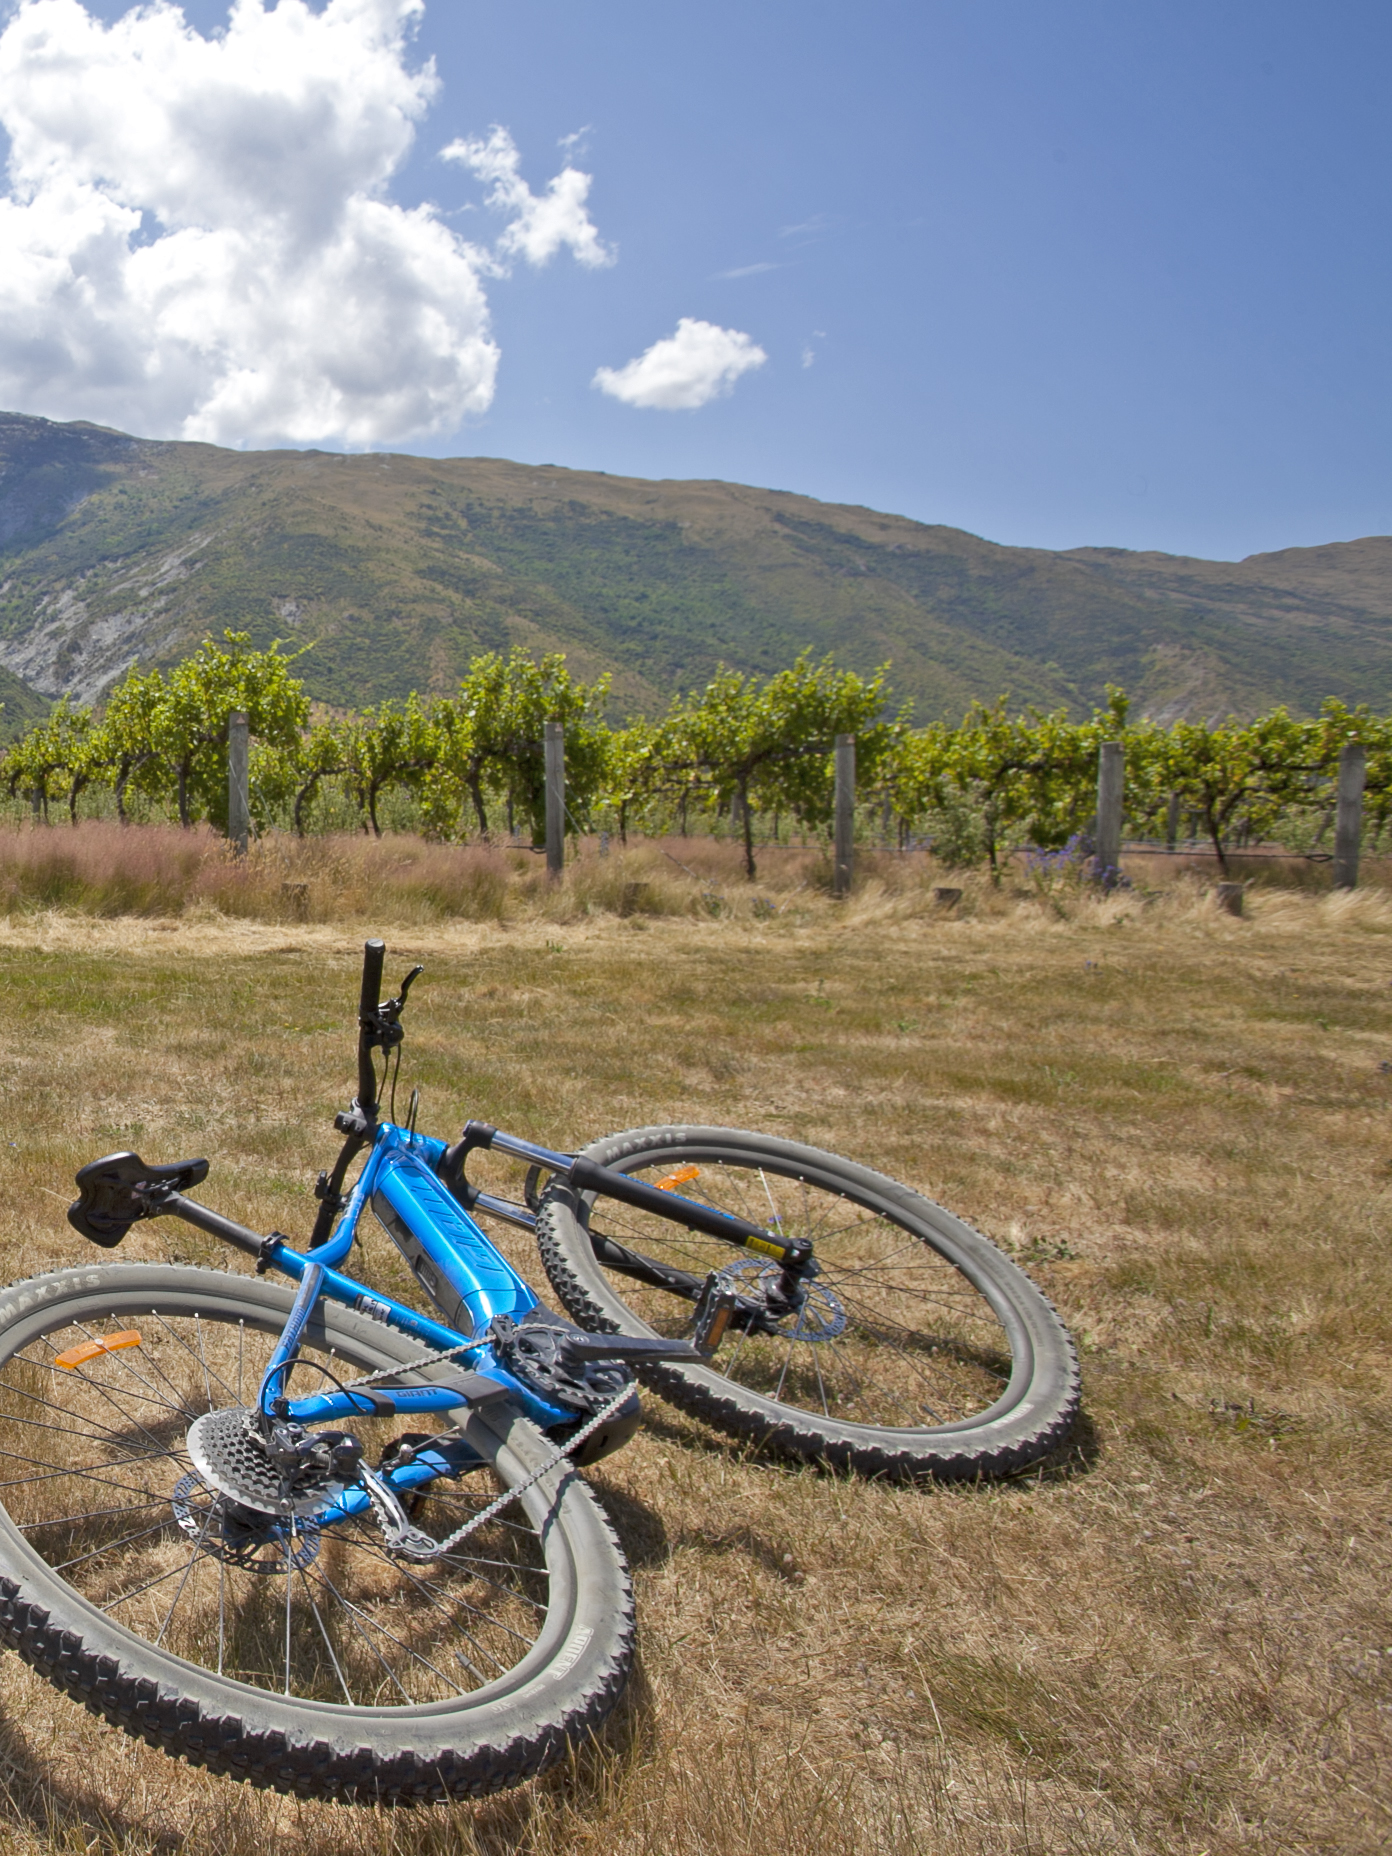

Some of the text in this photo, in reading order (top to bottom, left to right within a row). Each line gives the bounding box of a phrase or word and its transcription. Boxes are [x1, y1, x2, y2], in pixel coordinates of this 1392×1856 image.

[605, 1132, 687, 1161] MAXXIS
[283, 1304, 306, 1350] FATHOM
[395, 1388, 438, 1398] GIANT
[551, 1623, 595, 1680] ARDENT
